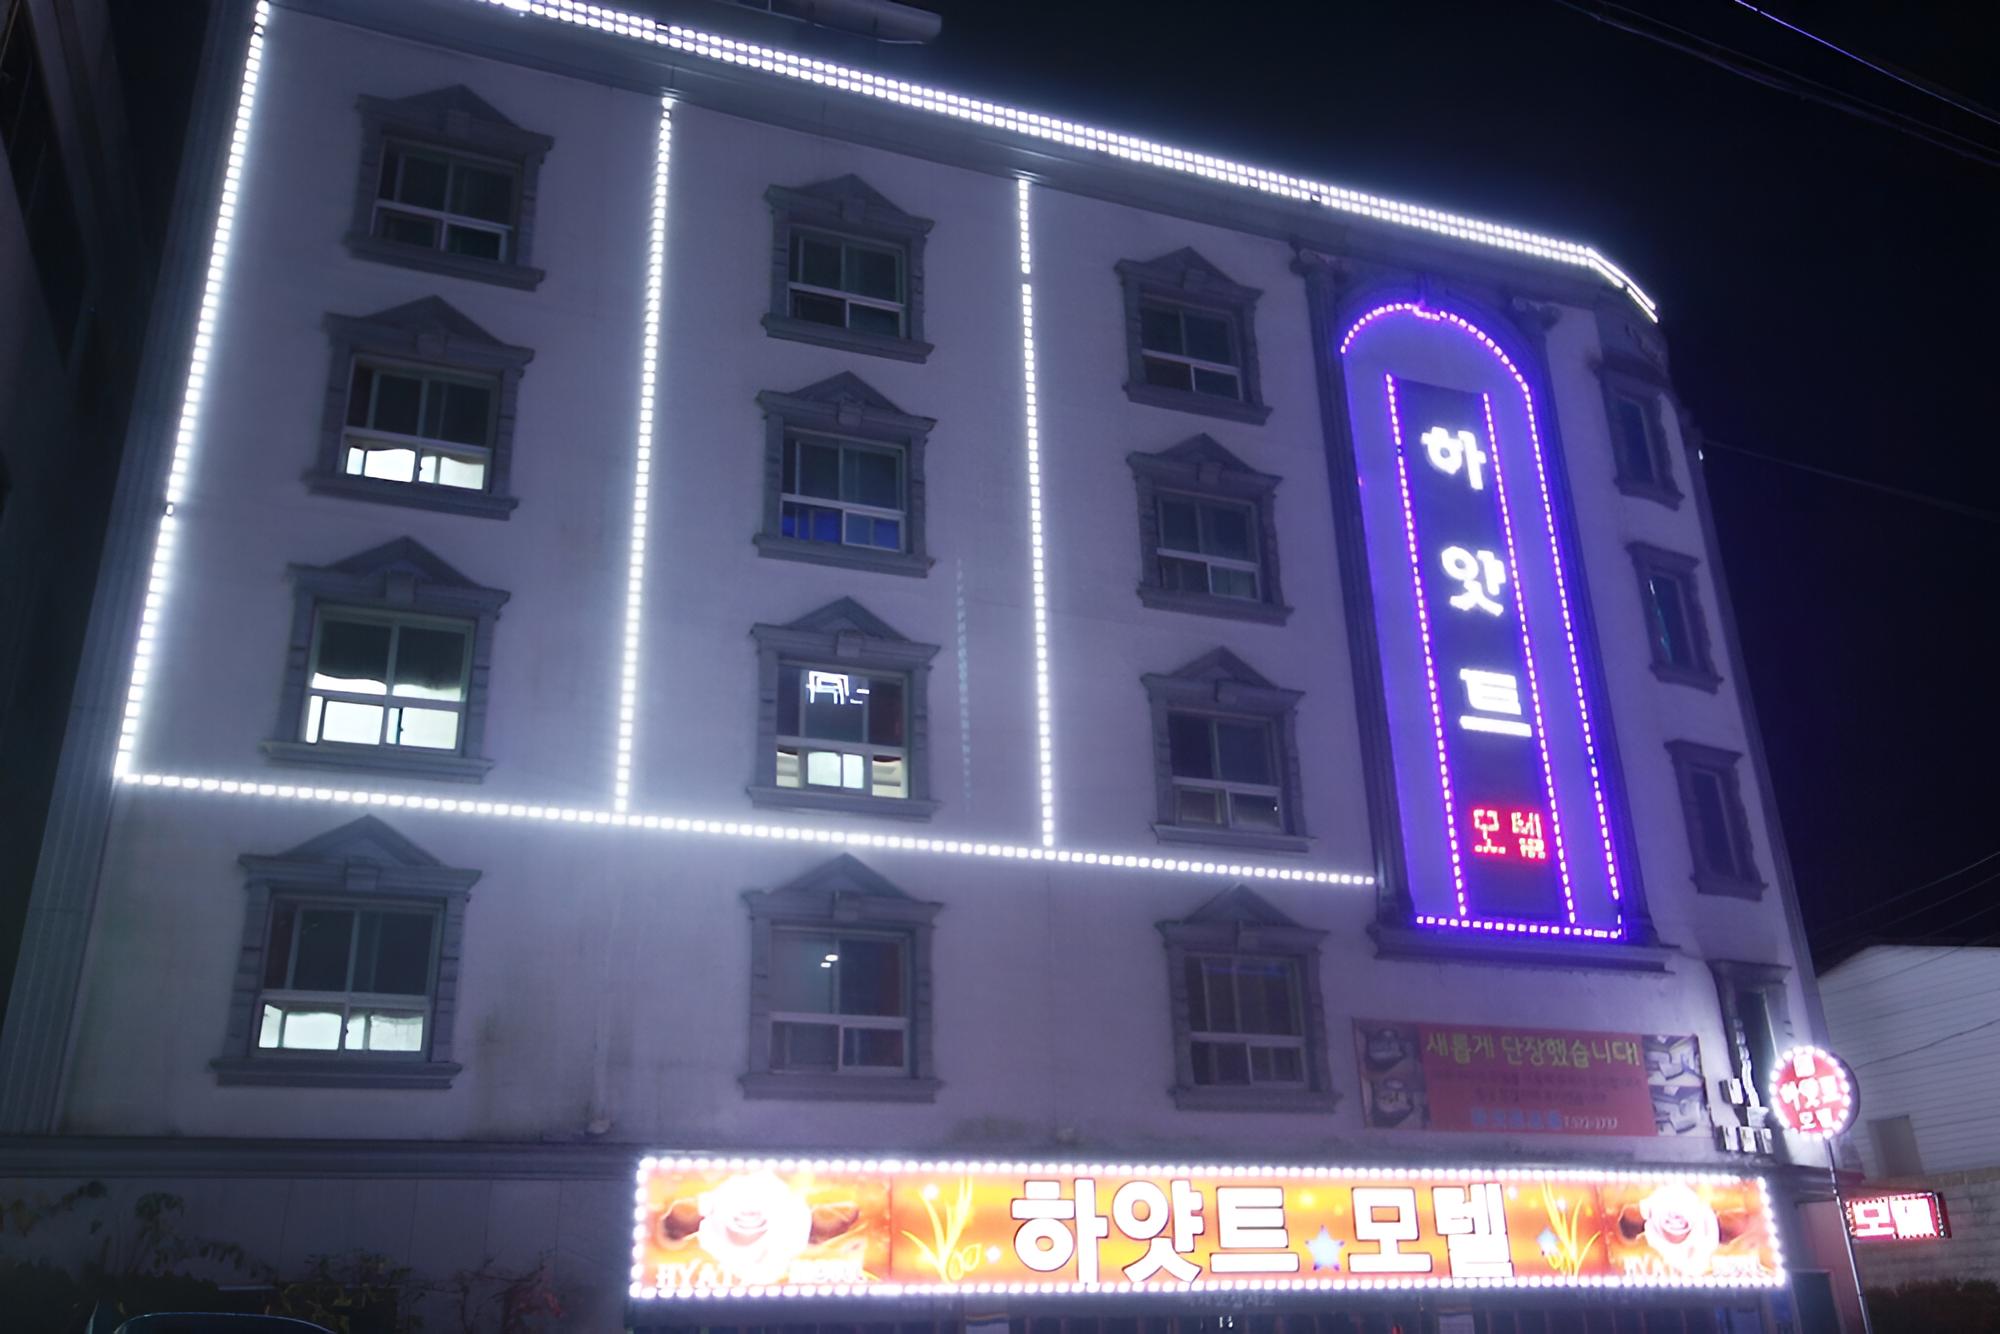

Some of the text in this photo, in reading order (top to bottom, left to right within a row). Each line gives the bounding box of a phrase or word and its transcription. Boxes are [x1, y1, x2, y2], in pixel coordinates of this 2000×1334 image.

[1421, 425, 1532, 738] 하얏트
[1473, 809, 1546, 859] 모텔
[1011, 1178, 1514, 1283] 하얏트 모텔
